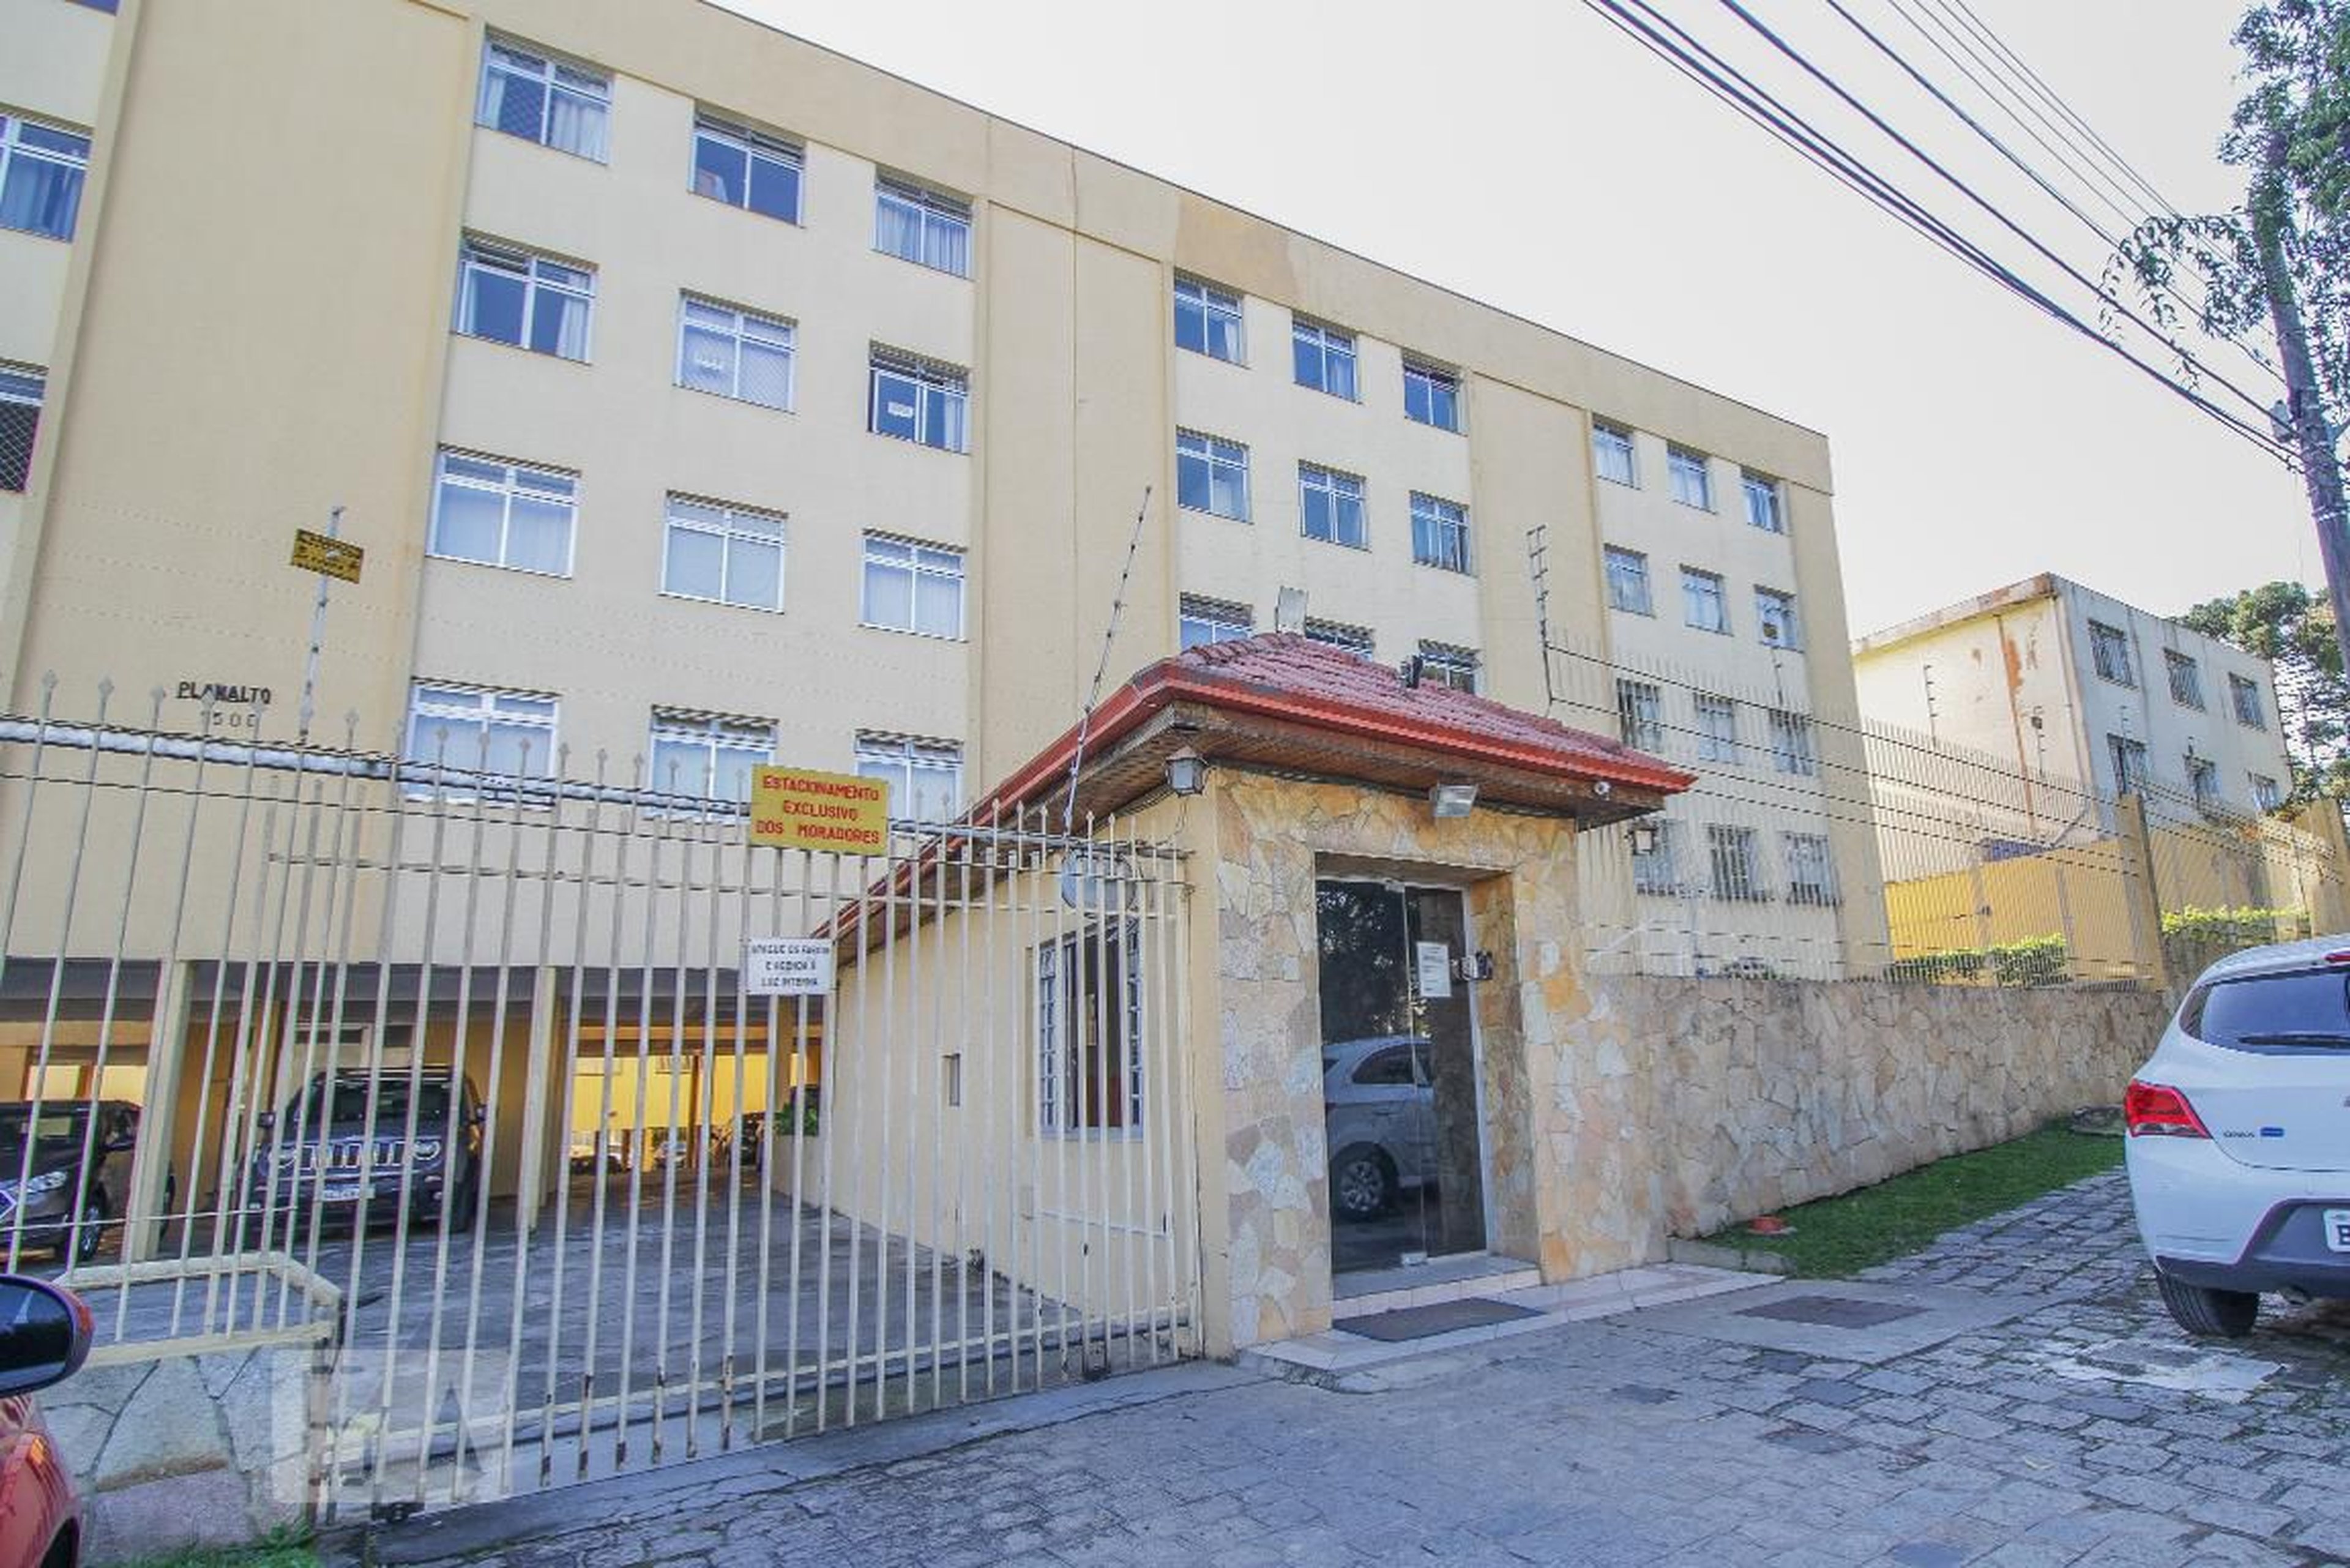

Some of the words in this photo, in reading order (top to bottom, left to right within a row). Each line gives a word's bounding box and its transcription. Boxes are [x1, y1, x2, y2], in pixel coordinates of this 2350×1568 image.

[763, 775, 879, 801] ESTACIONAMENTO
[783, 800, 858, 821] EXCLUSIVO
[756, 819, 784, 834] DOS
[797, 824, 879, 844] MORADORES
